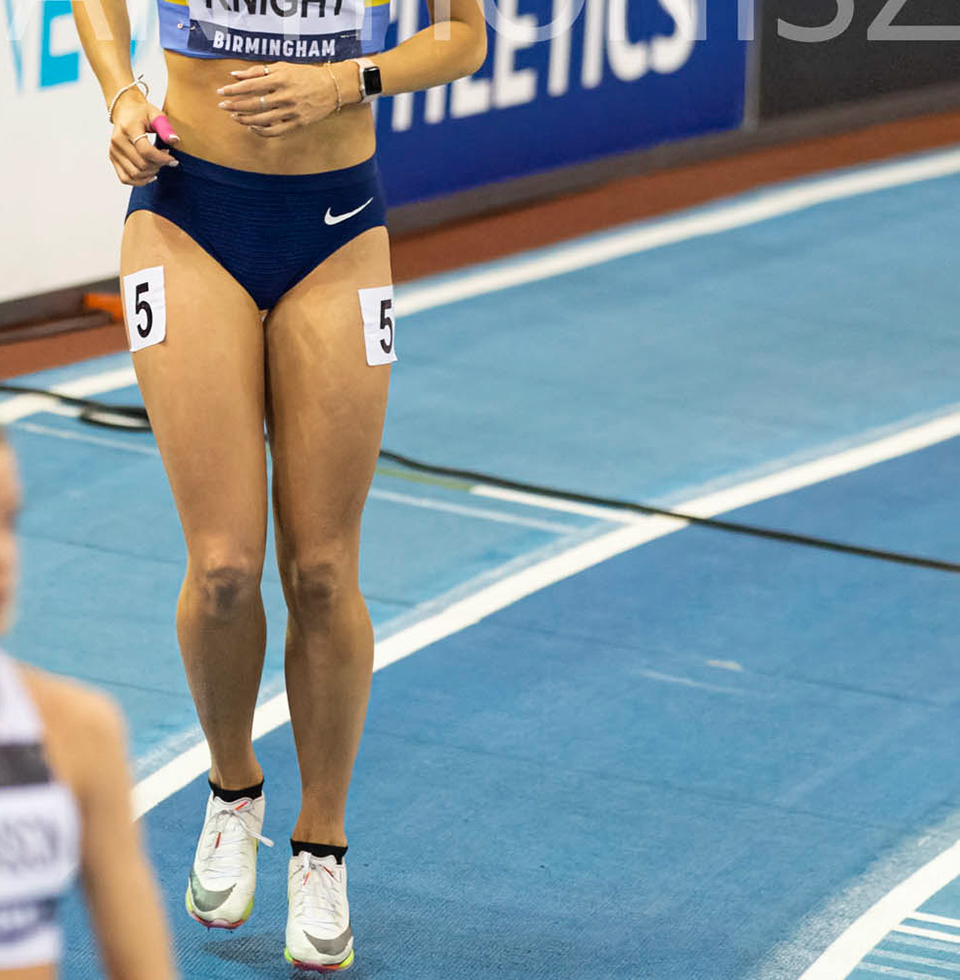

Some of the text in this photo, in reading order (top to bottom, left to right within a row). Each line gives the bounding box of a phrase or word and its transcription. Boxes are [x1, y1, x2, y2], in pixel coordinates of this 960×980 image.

[213, 30, 336, 57] BIRMINGHAM
[135, 282, 153, 338] 5
[379, 299, 392, 354] 5
